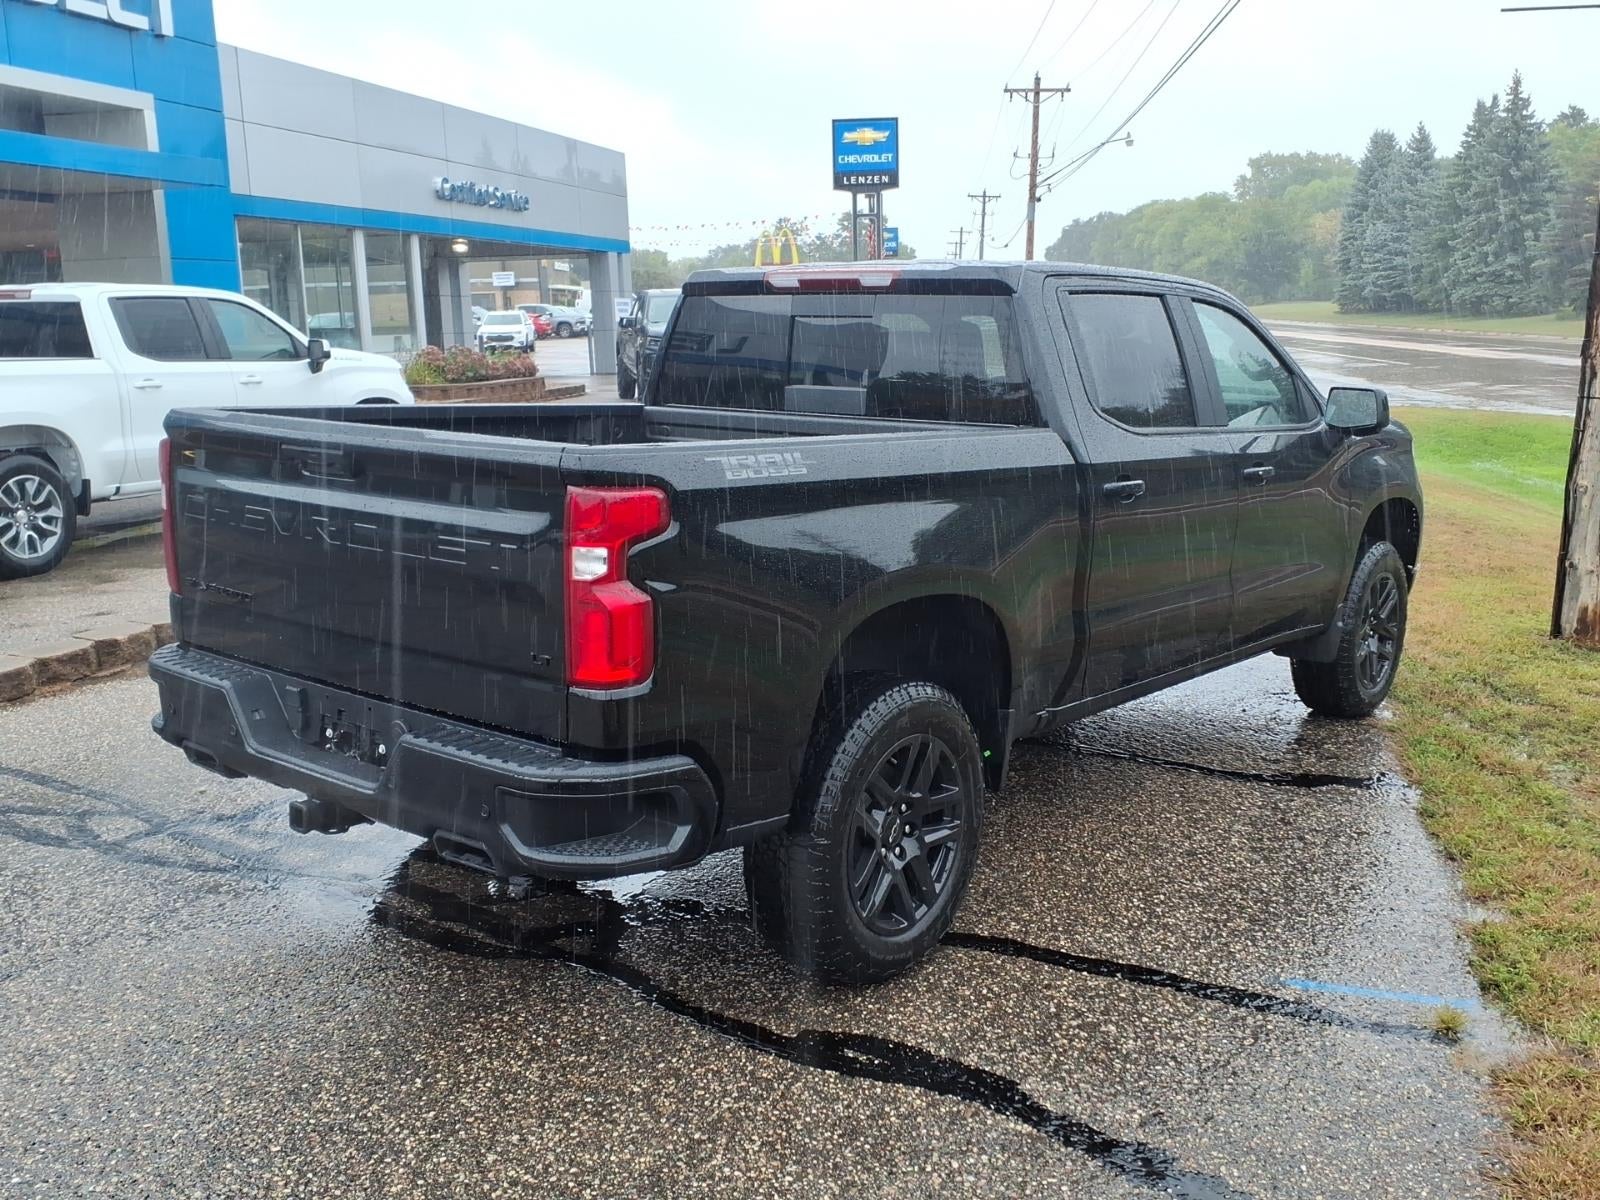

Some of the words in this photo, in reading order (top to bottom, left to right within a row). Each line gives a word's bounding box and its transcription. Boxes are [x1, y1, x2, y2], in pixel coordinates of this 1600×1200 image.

[838, 153, 893, 164] CHEVROLET
[843, 175, 889, 185] LENZEN
[434, 177, 489, 207] Certified
[489, 186, 530, 212] Service
